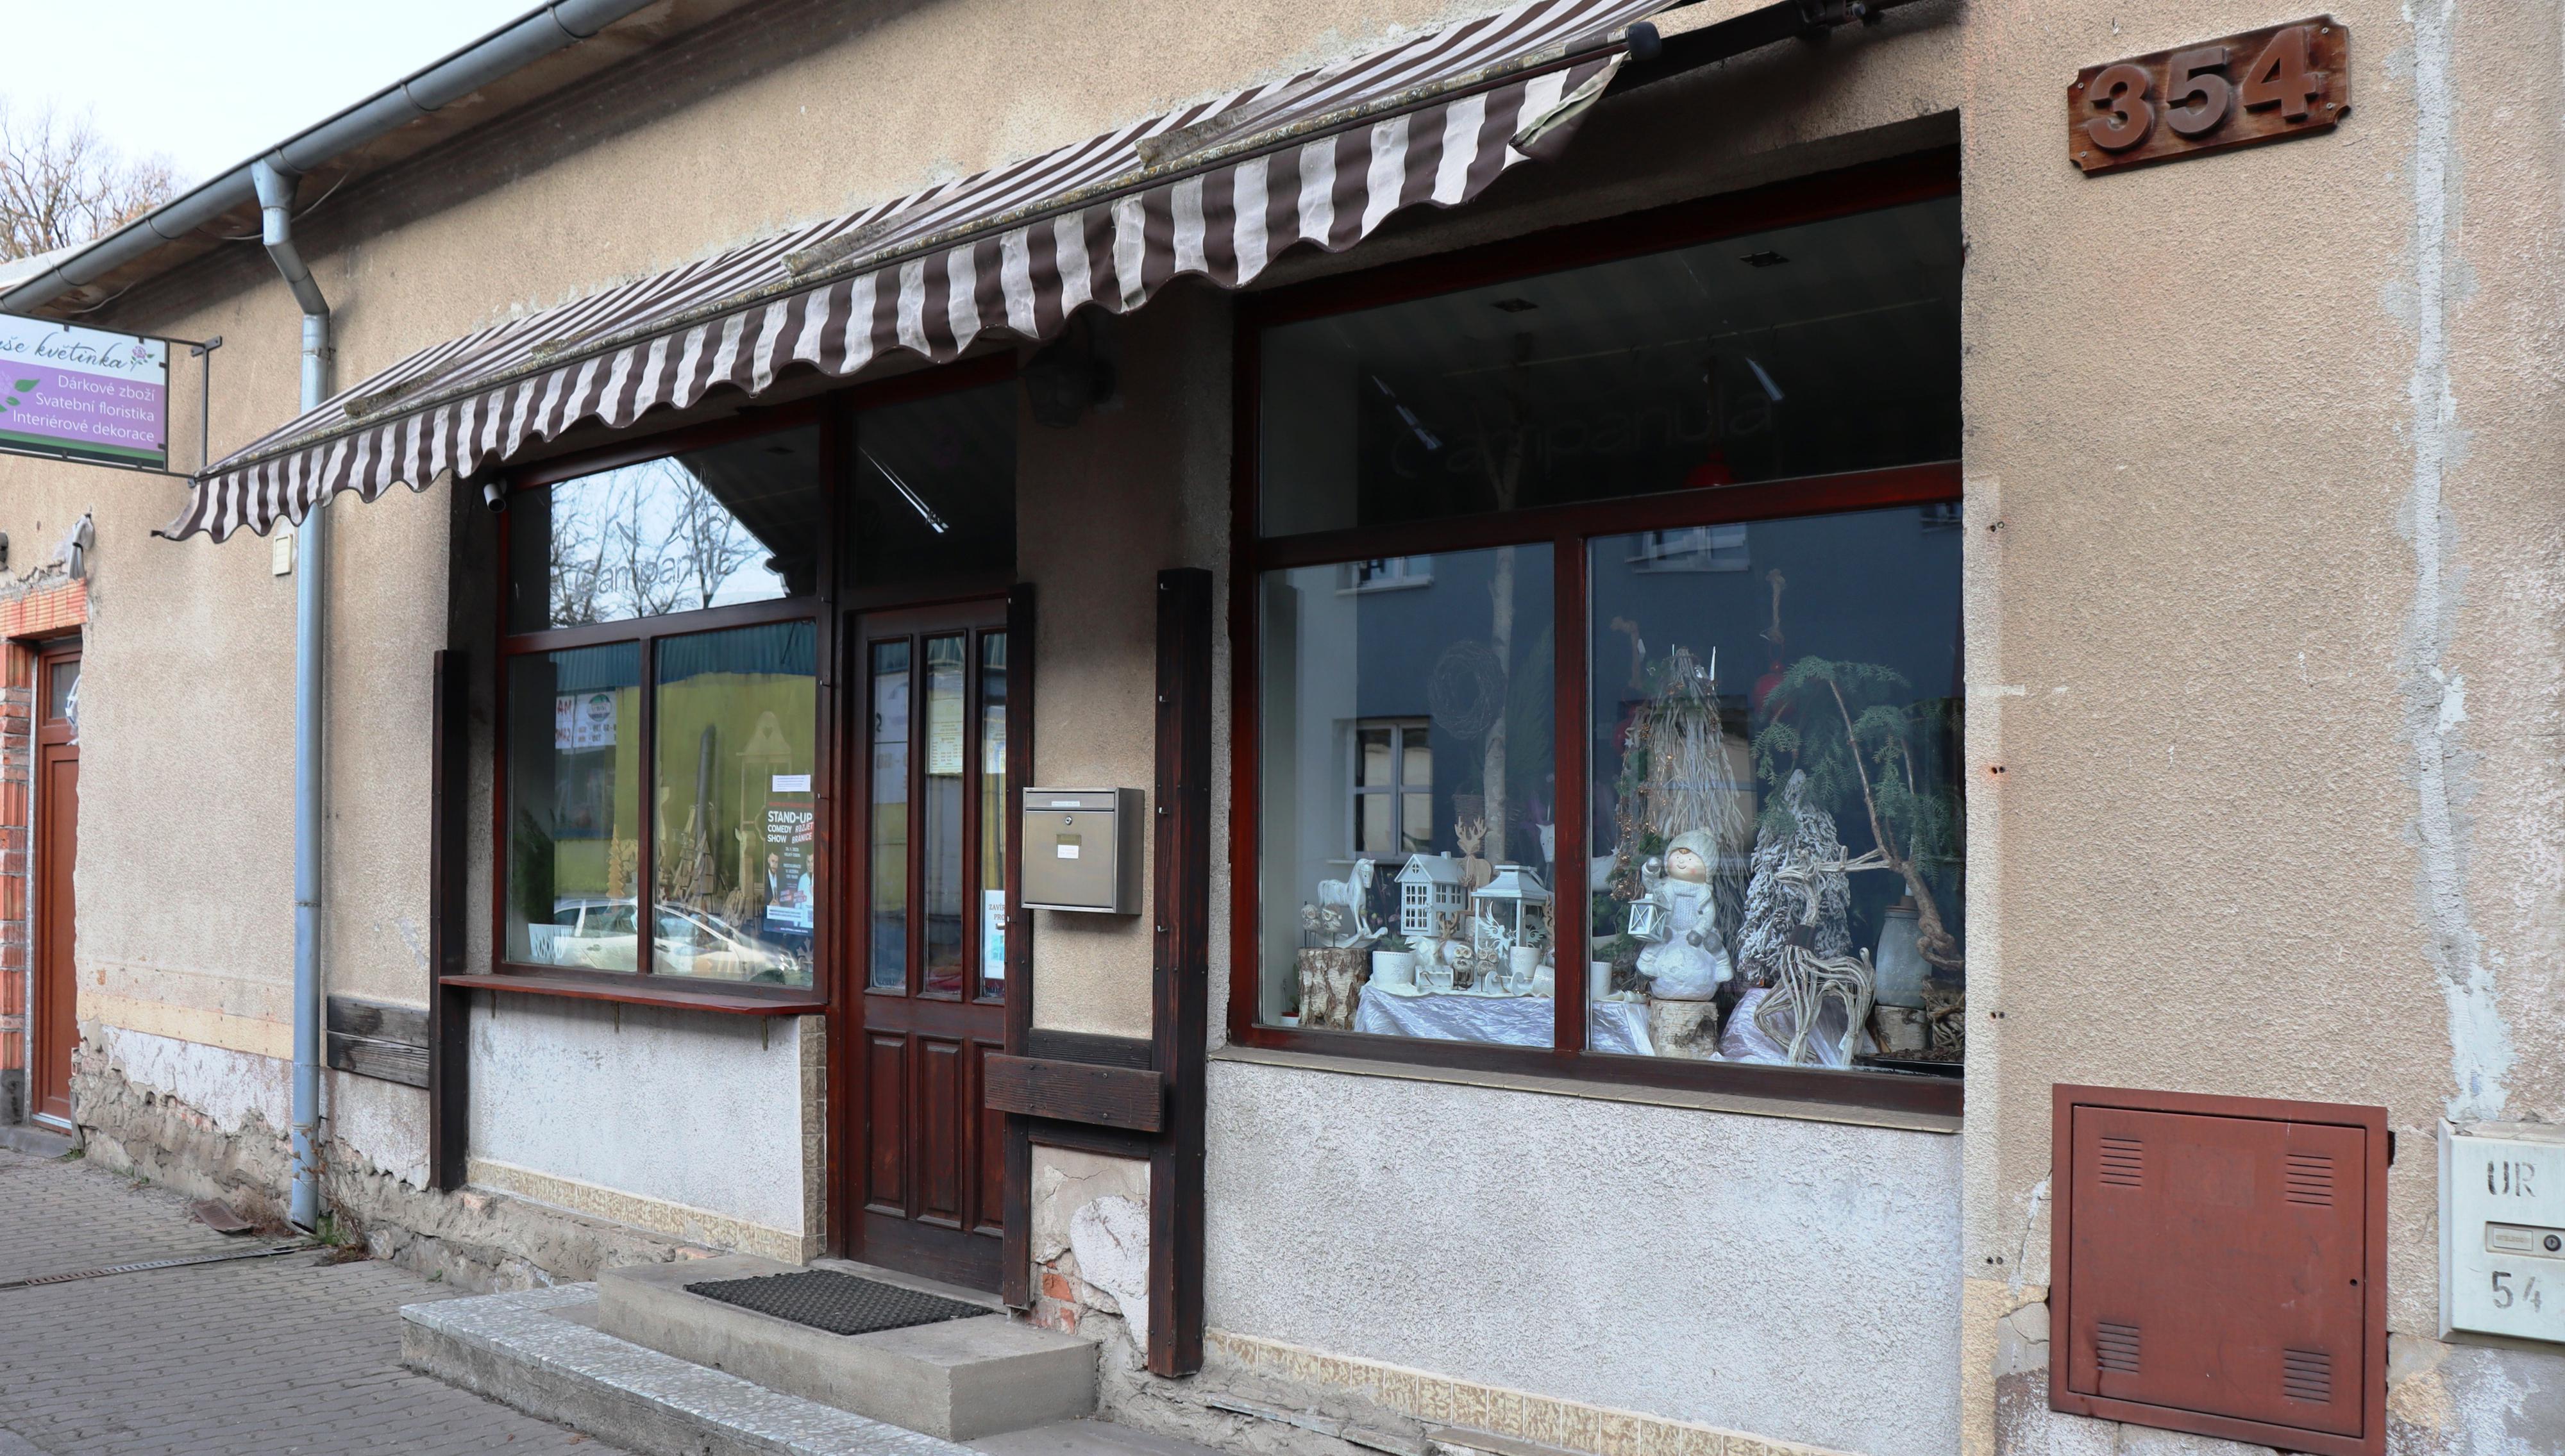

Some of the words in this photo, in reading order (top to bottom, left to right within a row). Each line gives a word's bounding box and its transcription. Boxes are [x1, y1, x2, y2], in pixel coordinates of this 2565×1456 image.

[2087, 27, 2318, 153] 354
[0, 335, 28, 353] še
[35, 331, 128, 370] květinka
[58, 374, 115, 396] Dárkové
[119, 385, 155, 402] zboží
[35, 392, 95, 413] Svatební
[99, 401, 155, 423] floristika
[13, 409, 88, 433] Interiérové
[92, 422, 155, 442] dekorace
[767, 824, 792, 833] COMEDY
[768, 810, 812, 824] STAND-UP
[767, 833, 787, 843] SHOW
[2487, 1160, 2537, 1198] UR
[2491, 1270, 2543, 1314] 54
